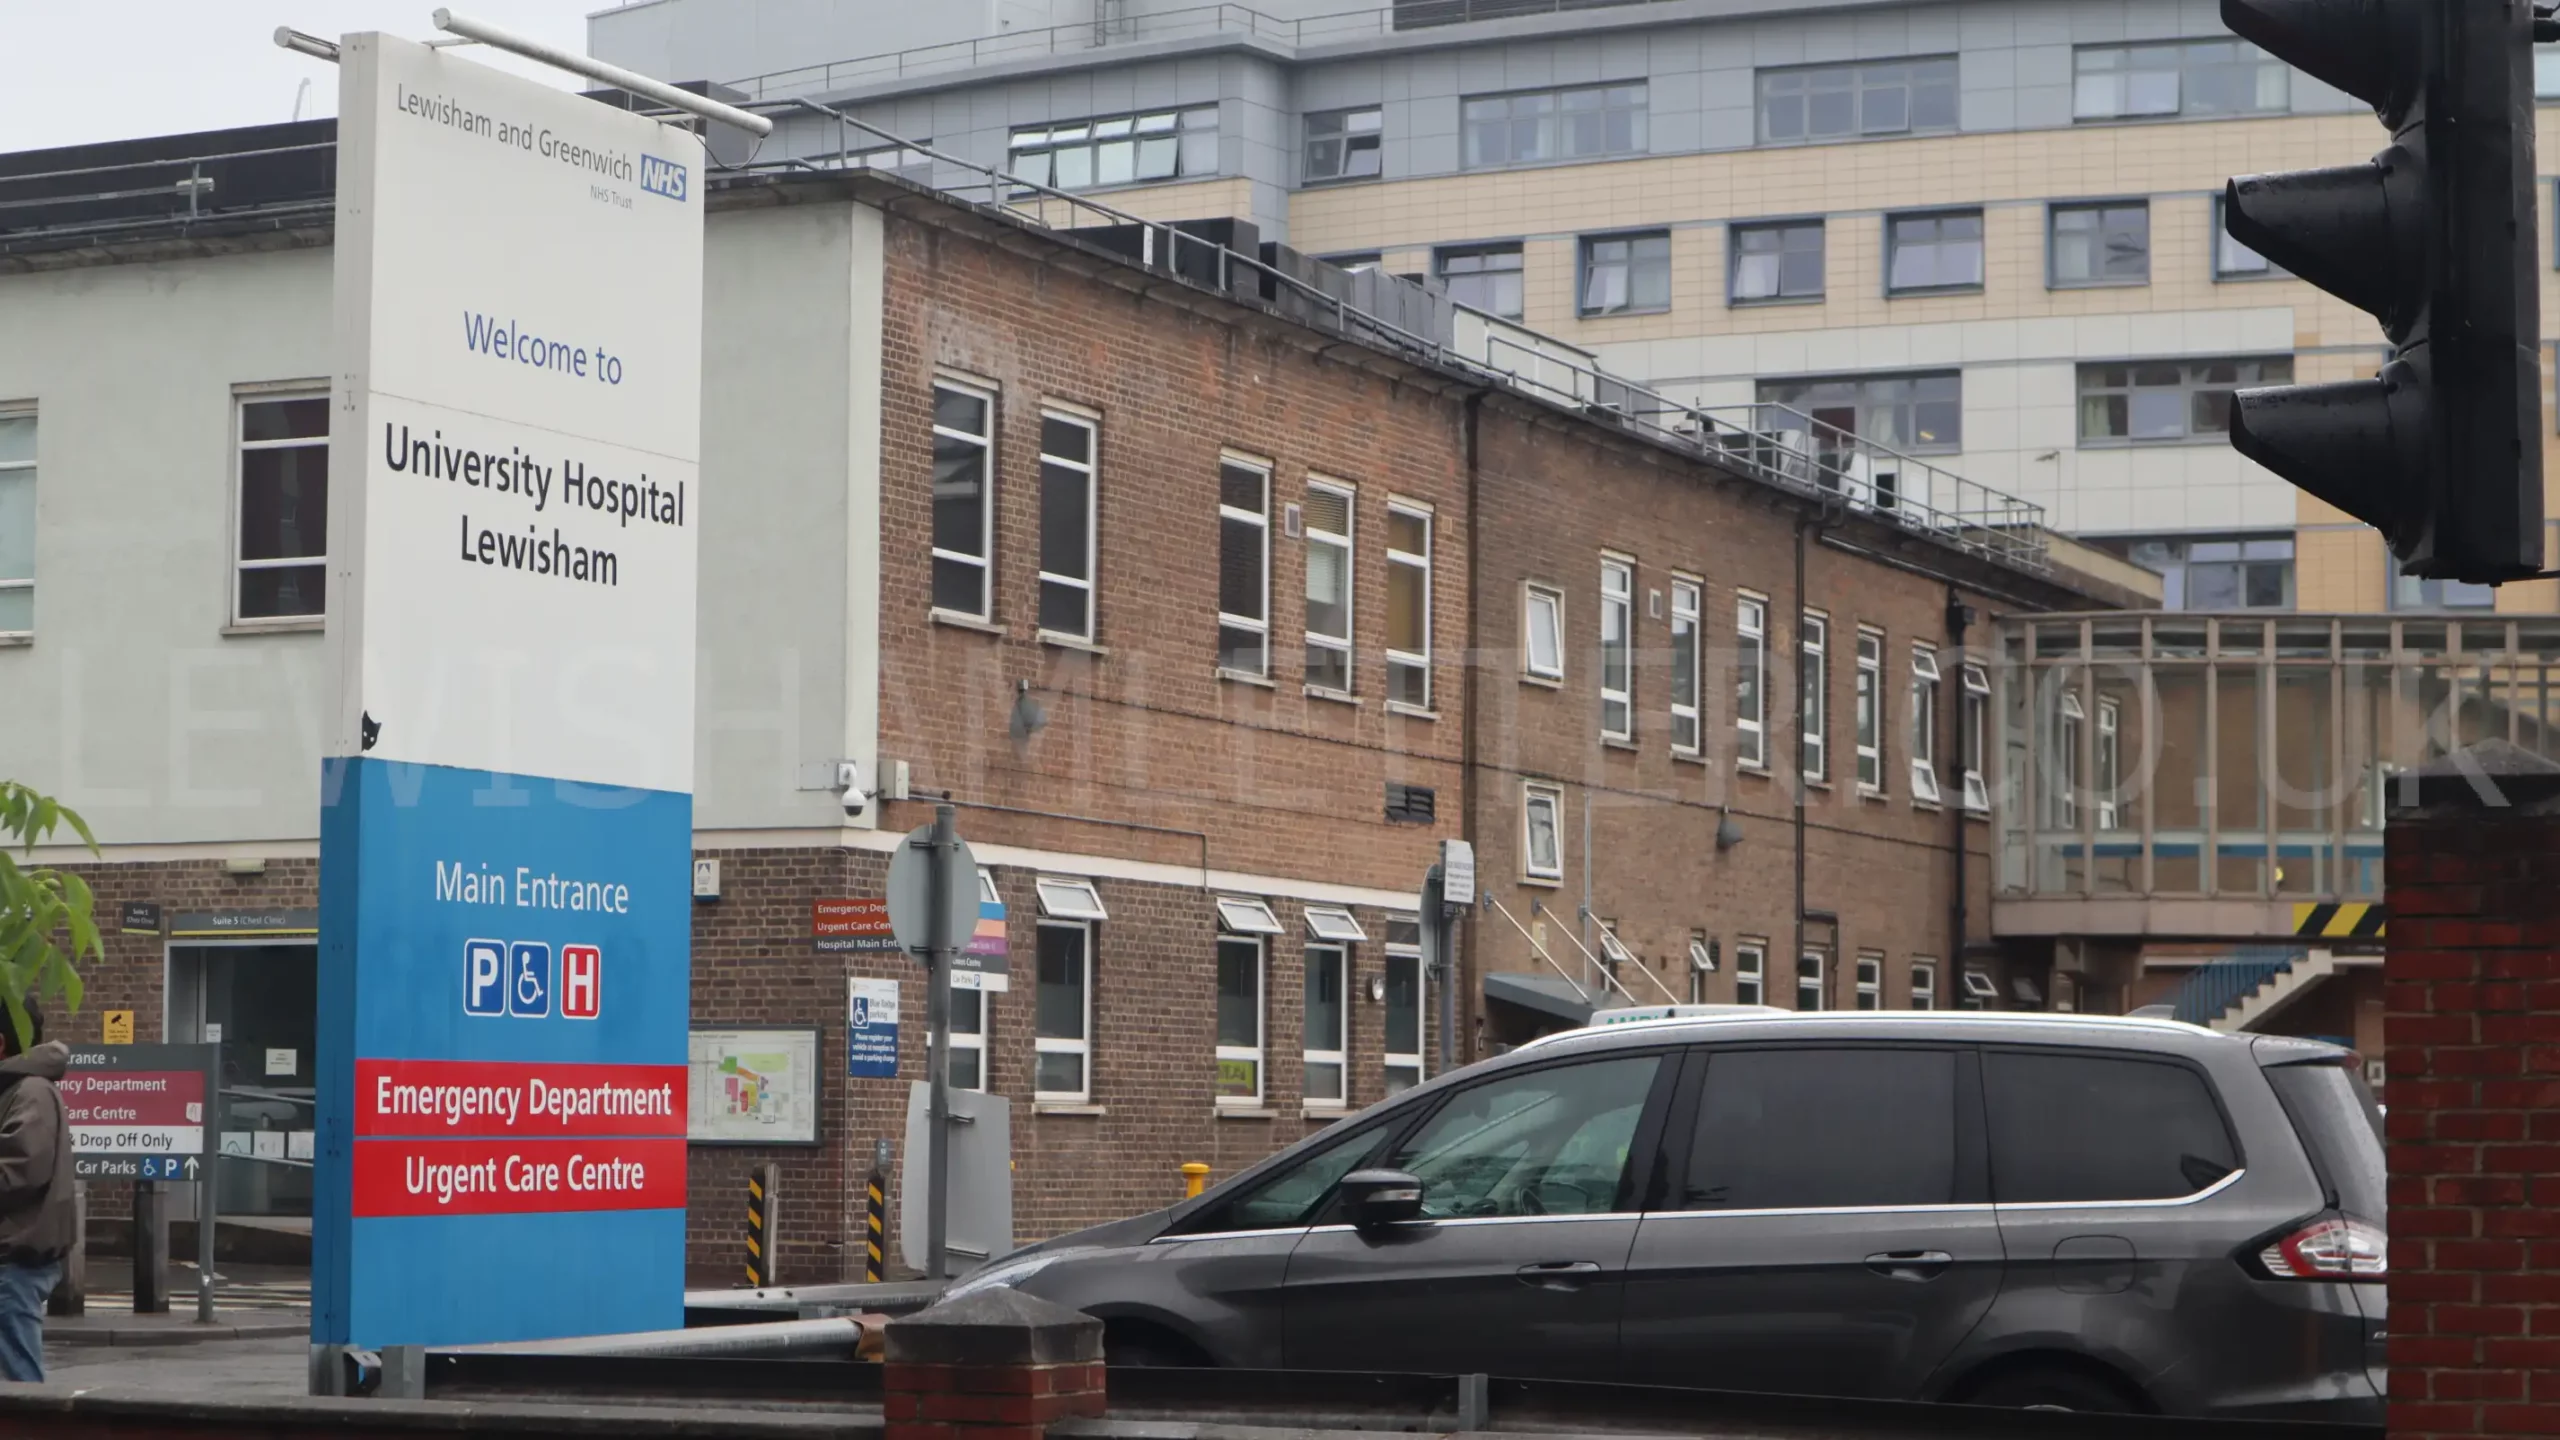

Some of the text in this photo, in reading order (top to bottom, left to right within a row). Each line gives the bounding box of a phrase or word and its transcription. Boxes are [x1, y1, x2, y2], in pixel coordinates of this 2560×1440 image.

[398, 83, 632, 182] Lewisham and Greenwich
[641, 156, 686, 199] NHS
[590, 184, 633, 211] NHS Trust
[464, 310, 622, 385] Welcome to
[386, 422, 684, 527] University Hospital
[461, 514, 617, 586] Lewisham
[435, 860, 629, 914] Main Entrance
[212, 916, 232, 925] Suite
[817, 903, 888, 915] Emergency Dep
[817, 921, 892, 933] Urgent Care Cen
[817, 940, 854, 951] Hospital
[857, 939, 880, 948] Main
[472, 948, 594, 1011] P H
[86, 1077, 167, 1094] Department
[377, 1076, 521, 1126] Emergency
[530, 1079, 672, 1125] Department
[93, 1105, 137, 1120] Centre
[80, 1133, 112, 1149] Drop
[116, 1132, 138, 1147] Off
[142, 1132, 173, 1150] Only
[75, 1159, 178, 1176] Car Parks P
[406, 1154, 644, 1204] Urgent Care Centre
